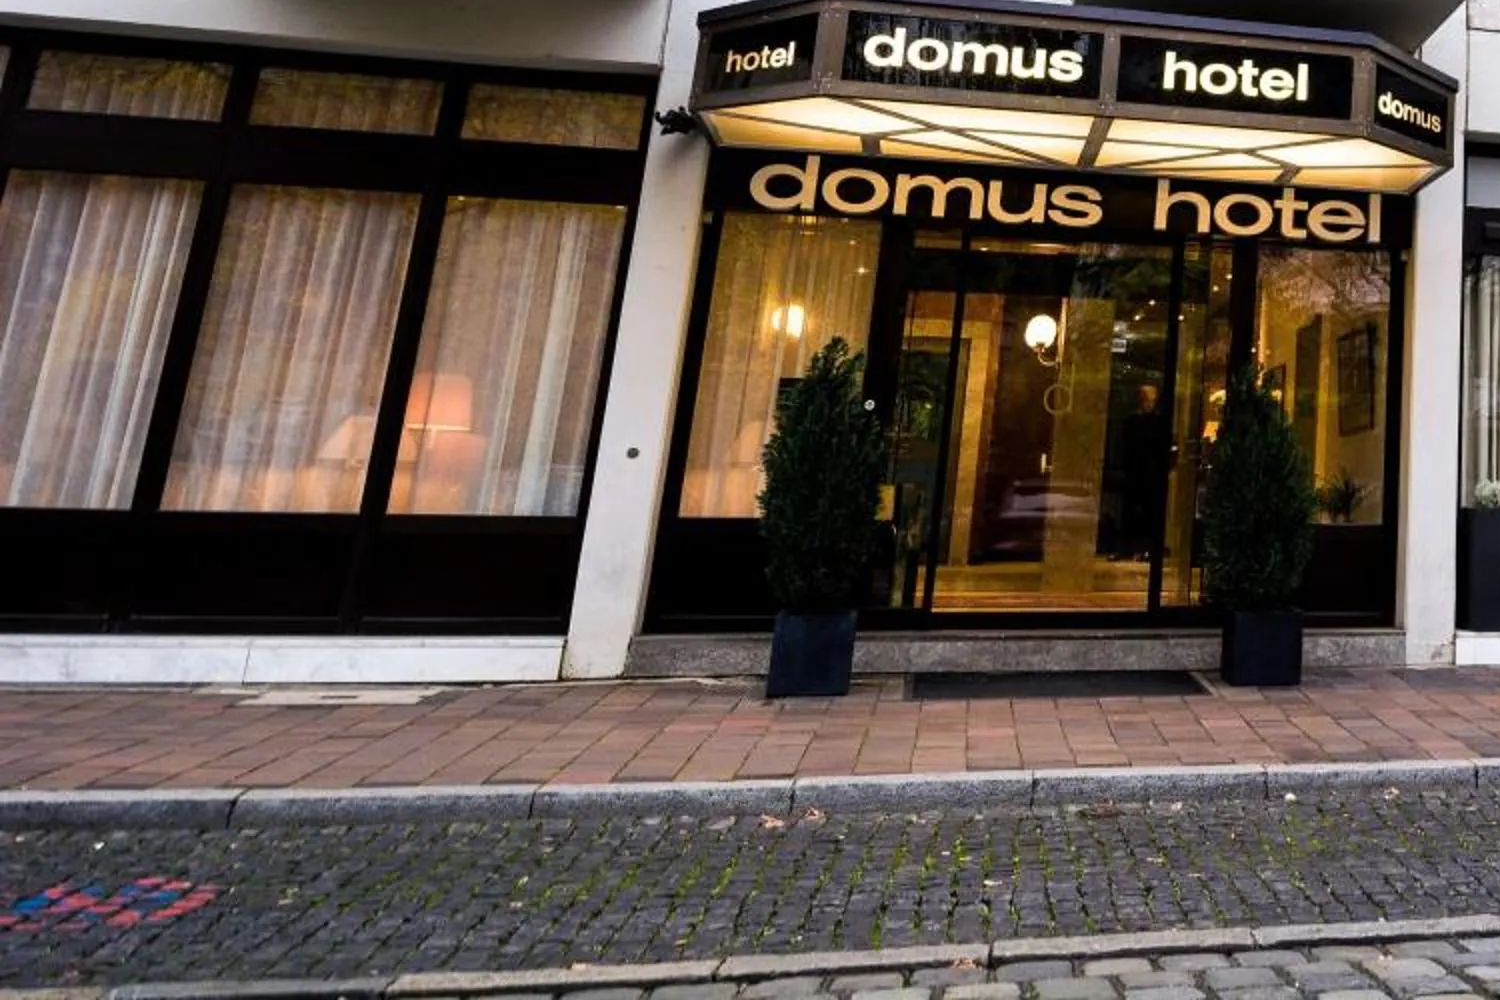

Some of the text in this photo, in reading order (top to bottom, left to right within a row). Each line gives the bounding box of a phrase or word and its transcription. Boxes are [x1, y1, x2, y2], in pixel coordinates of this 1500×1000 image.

[724, 40, 797, 73] hotel
[862, 25, 1310, 102] domus hotel
[1376, 90, 1443, 134] domus
[748, 154, 1383, 244] domus hotel
